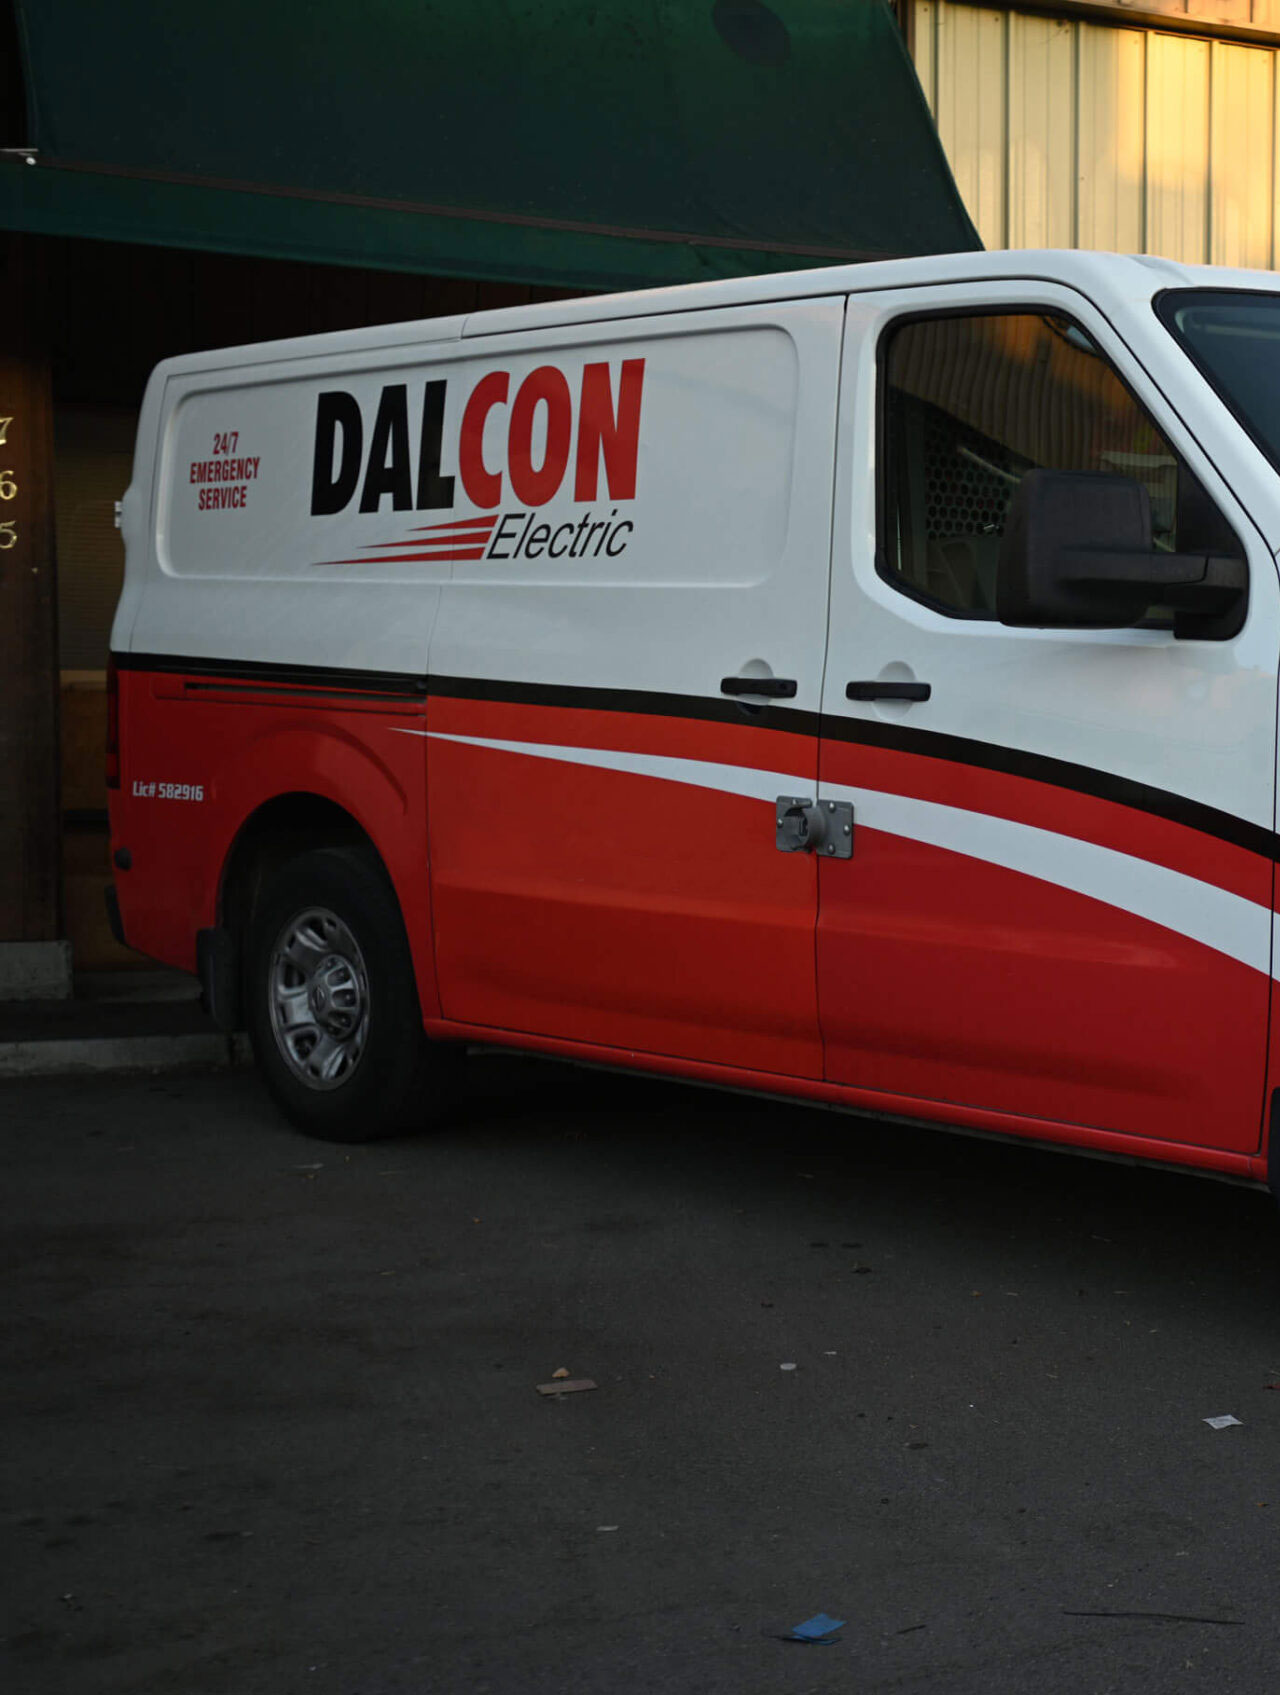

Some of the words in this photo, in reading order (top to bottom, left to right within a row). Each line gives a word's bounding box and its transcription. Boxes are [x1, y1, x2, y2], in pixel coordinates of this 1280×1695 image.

[212, 431, 239, 456] 24/7
[310, 358, 646, 516] DALCON
[190, 456, 261, 484] EMERGENCY
[198, 485, 248, 511] SERVICE
[486, 509, 634, 560] Electric
[132, 780, 156, 798] Lic#
[158, 782, 204, 801] 582916
